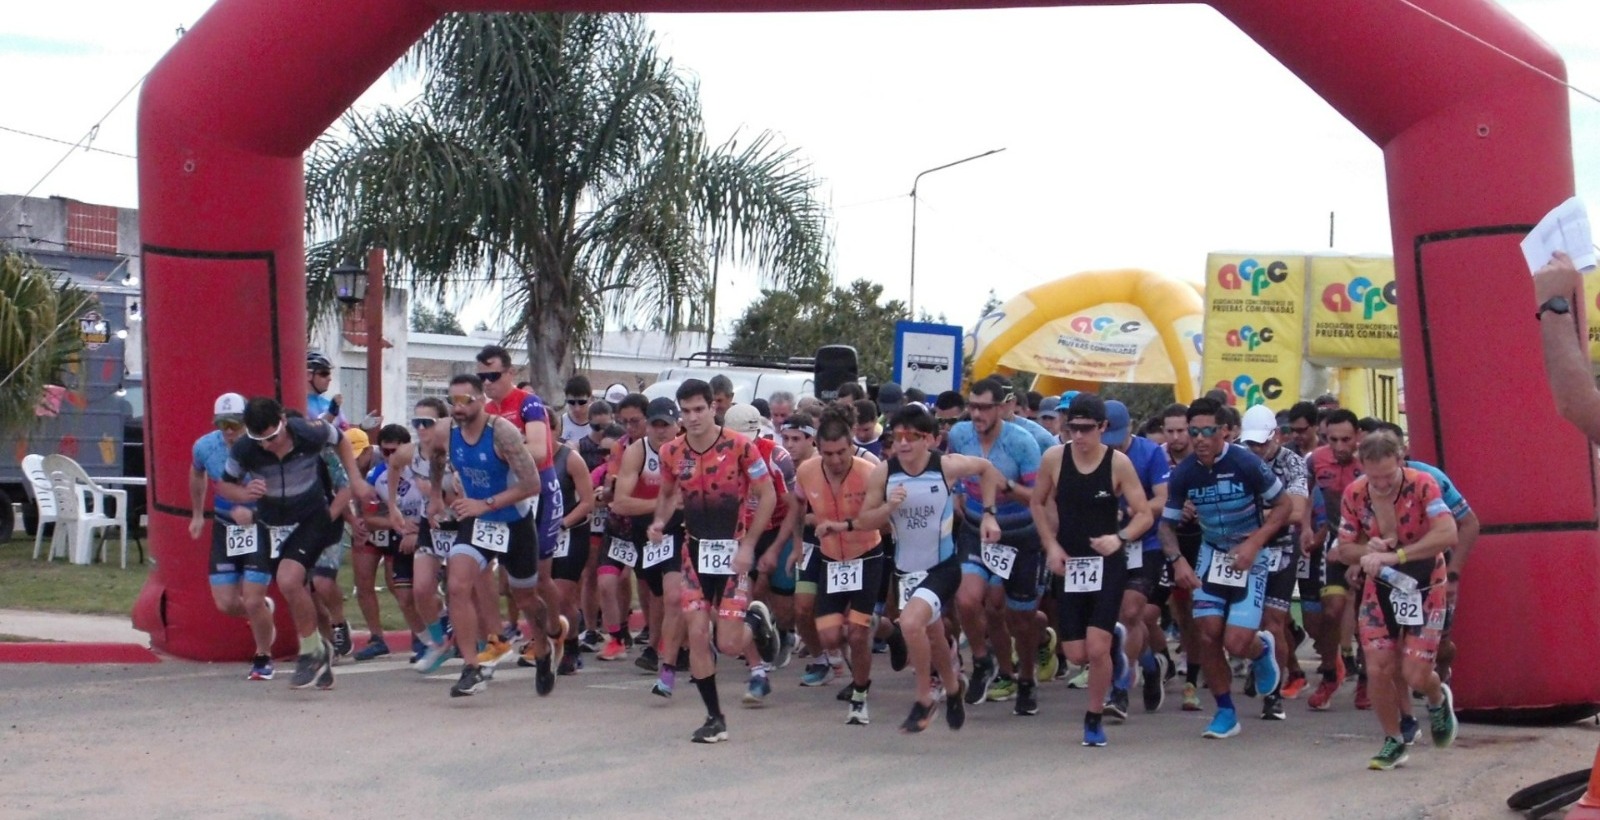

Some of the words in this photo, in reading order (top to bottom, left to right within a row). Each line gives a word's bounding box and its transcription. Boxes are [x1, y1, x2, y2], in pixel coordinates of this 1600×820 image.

[1245, 305, 1295, 314] COMBINADAS
[1315, 329, 1354, 337] PRUEBAS
[907, 518, 928, 529] ARG
[228, 535, 254, 549] 026
[476, 530, 504, 546] 213
[436, 539, 451, 553] 00
[647, 544, 670, 562] 019
[612, 546, 634, 562] 033
[702, 554, 731, 568] 184
[984, 551, 1010, 571] 055
[831, 571, 858, 586] 131
[1070, 570, 1098, 584] 114
[1216, 564, 1243, 580] 199
[1391, 601, 1418, 618] 082
